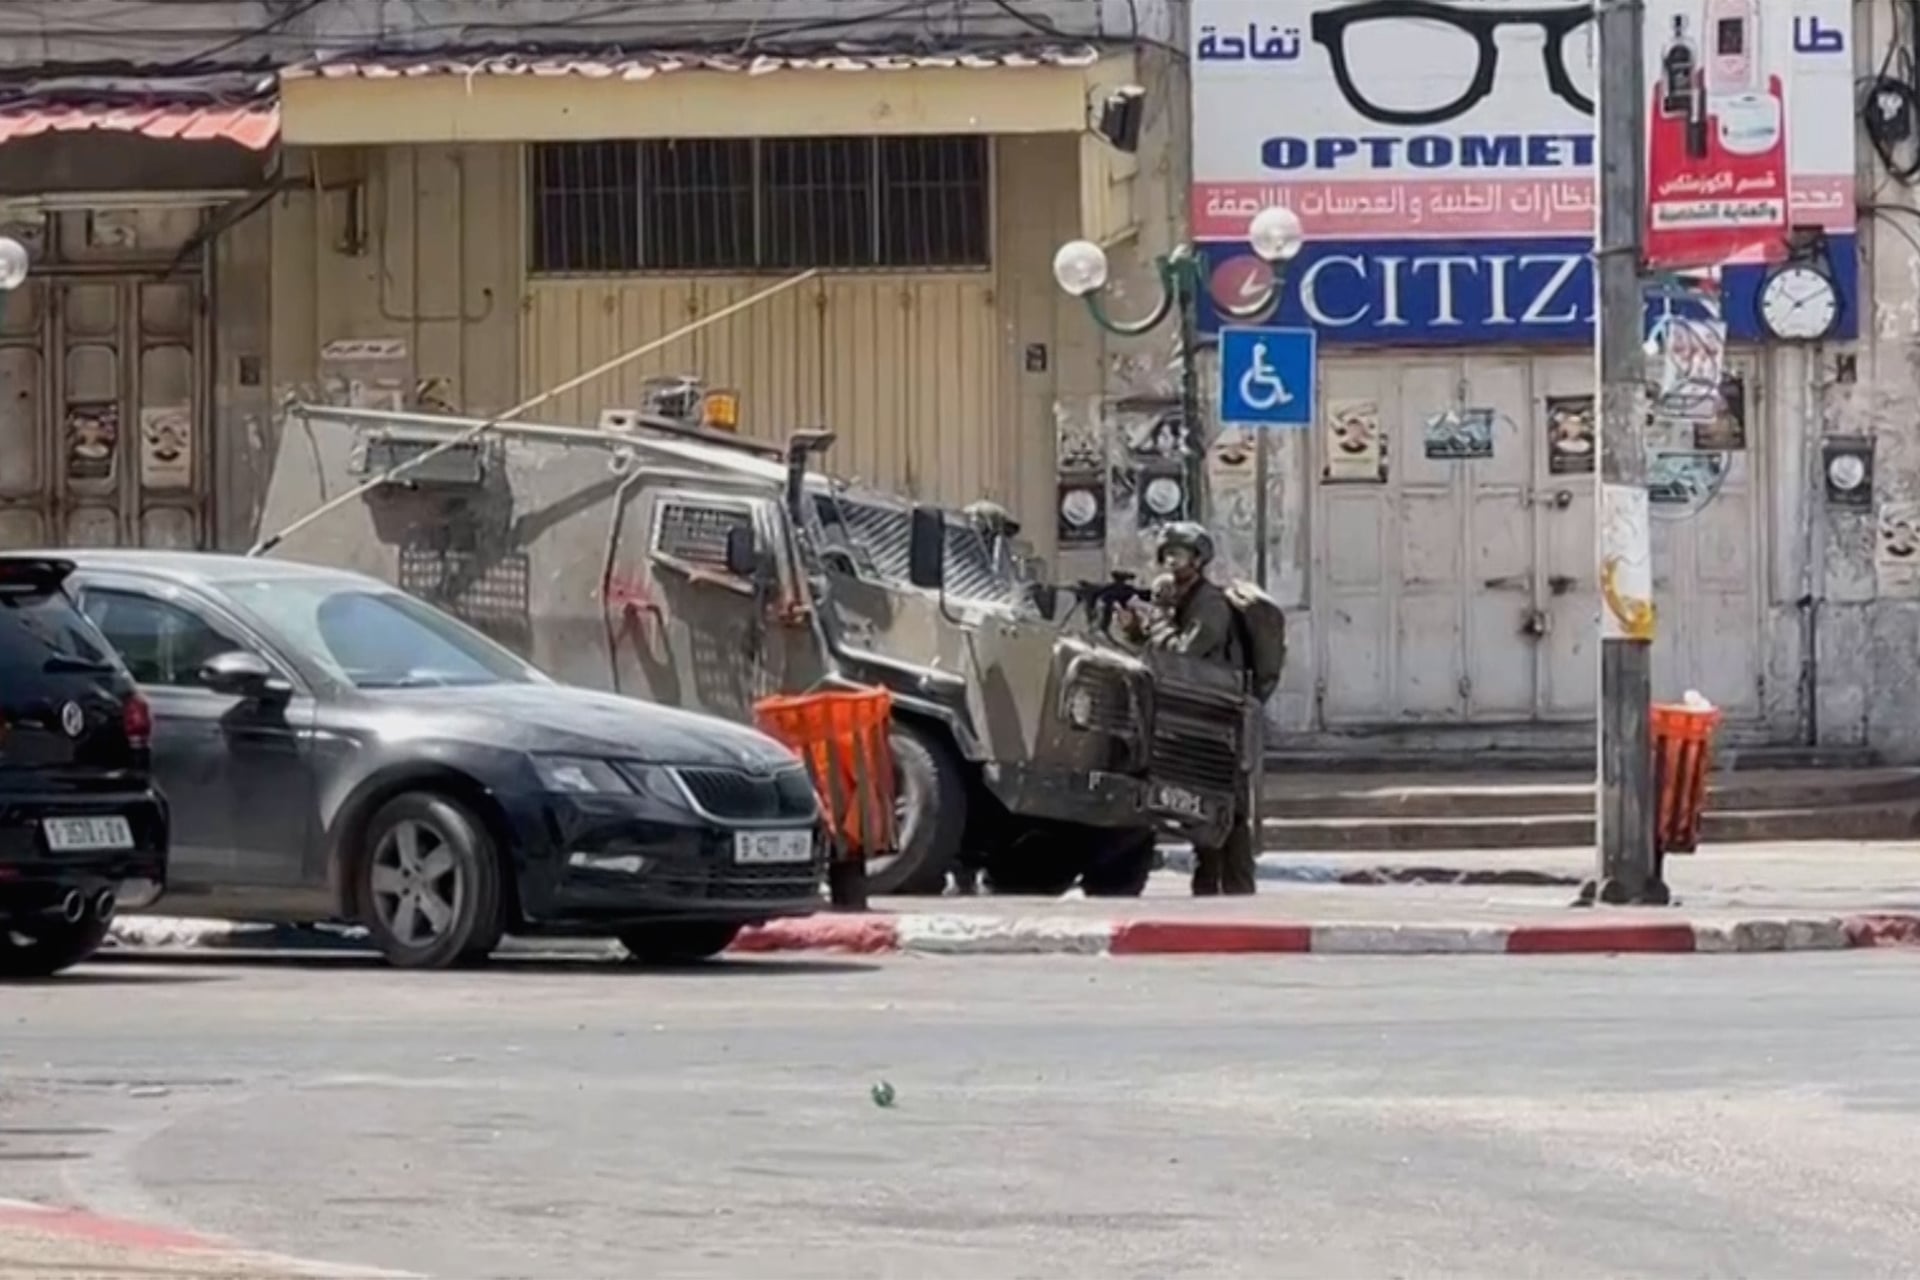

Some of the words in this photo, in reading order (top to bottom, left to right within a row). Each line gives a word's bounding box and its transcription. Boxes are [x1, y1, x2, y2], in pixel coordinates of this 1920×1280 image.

[1198, 23, 1300, 60] تفاحة
[1793, 16, 1843, 52] طا
[1261, 134, 1595, 169] OPTOMET
[1510, 182, 1595, 222] نظارات
[1300, 254, 1595, 327] CITIZ
